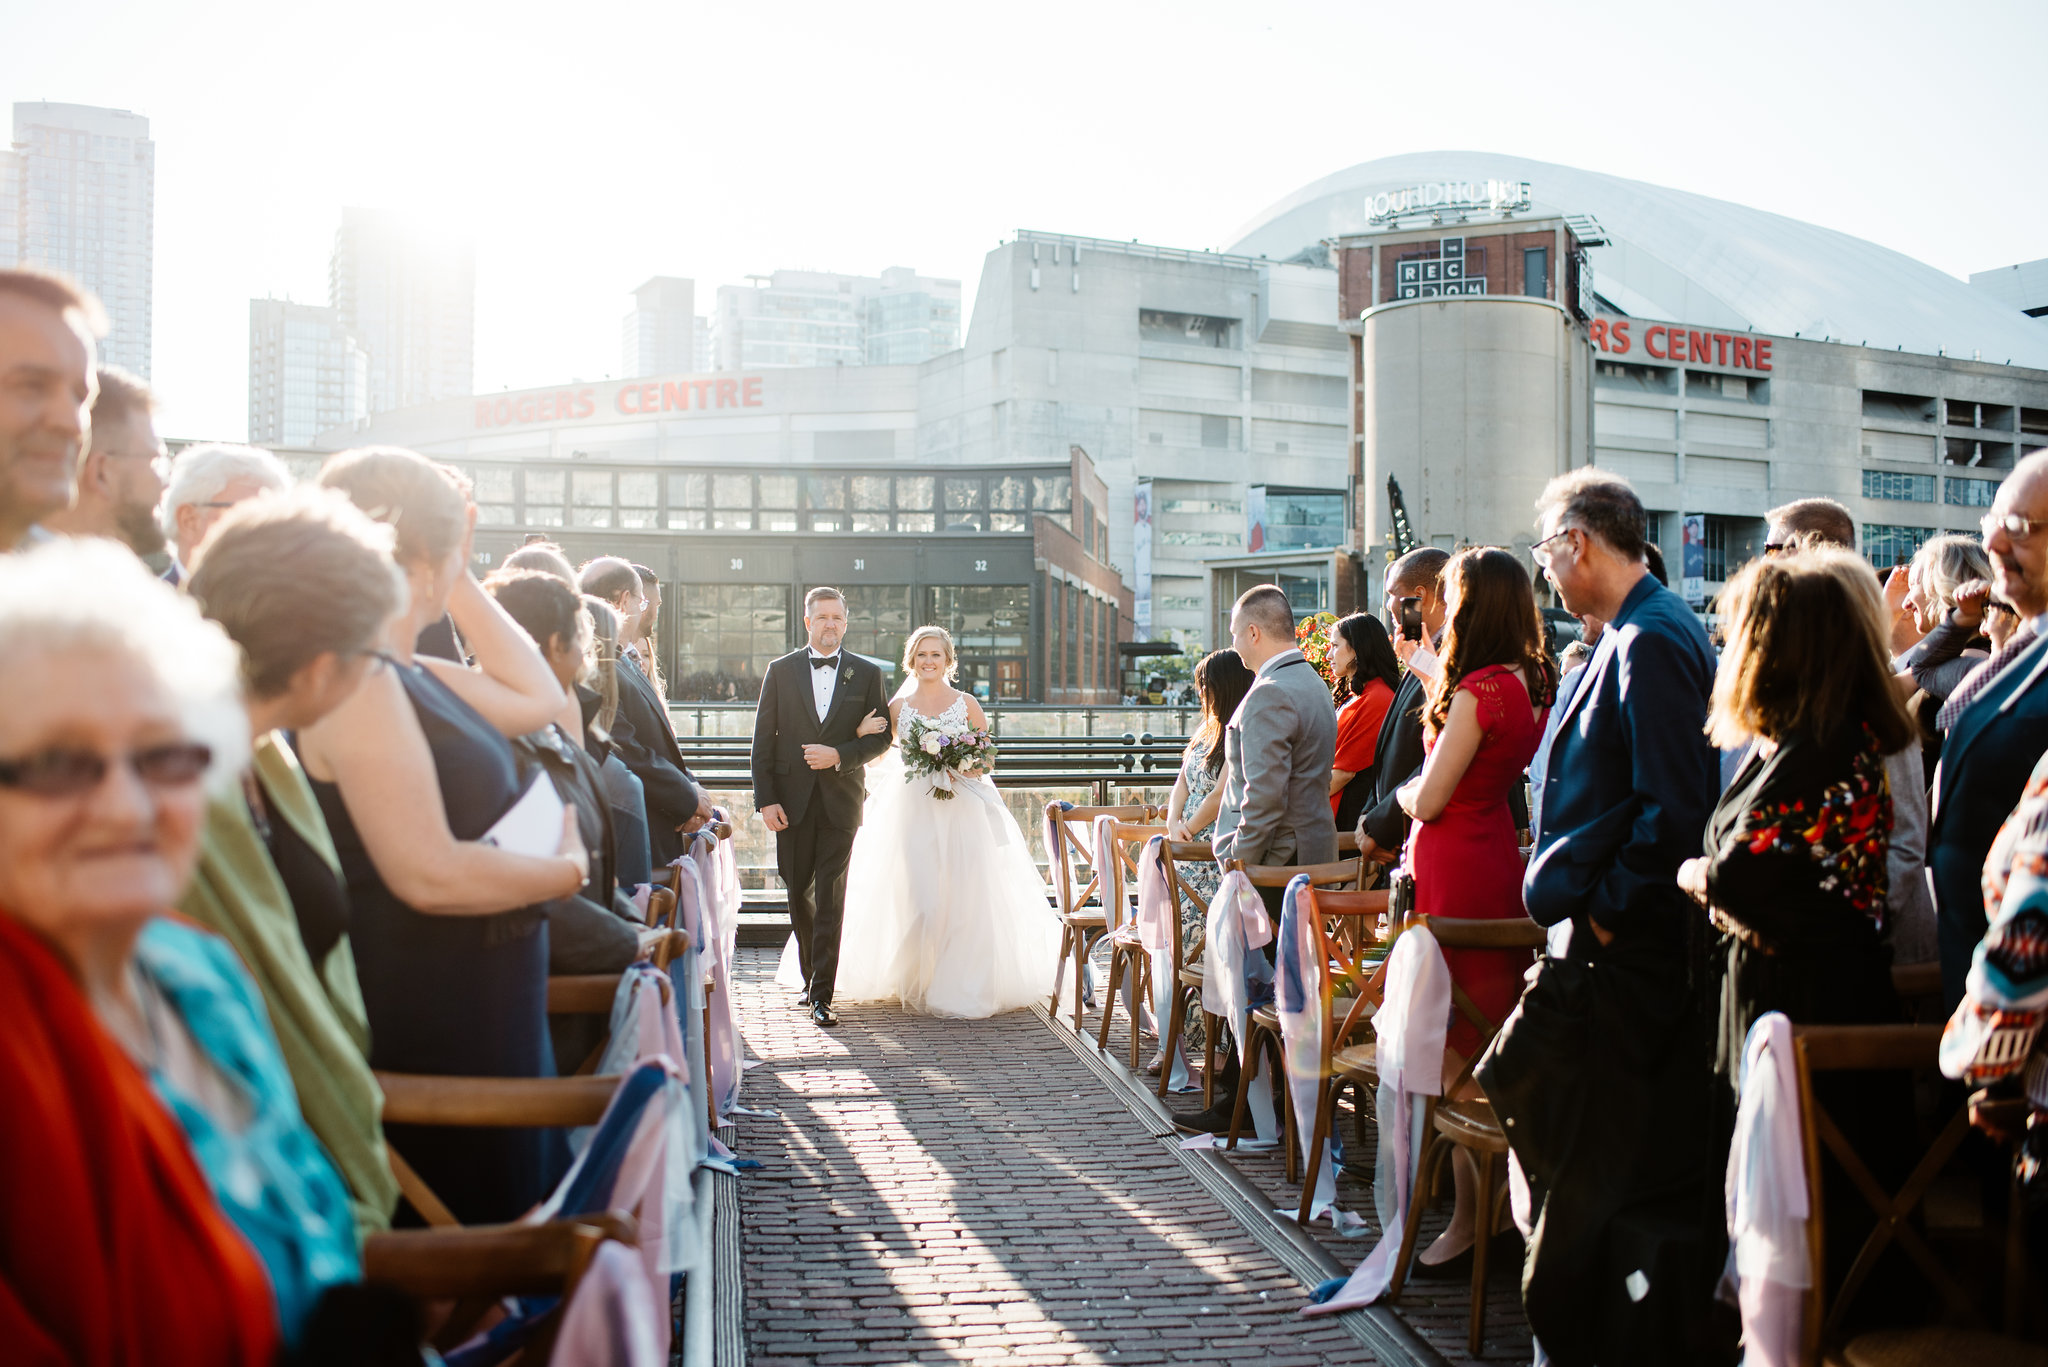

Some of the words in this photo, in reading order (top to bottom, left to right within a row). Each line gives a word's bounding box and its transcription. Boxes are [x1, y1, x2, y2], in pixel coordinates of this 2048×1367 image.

[1405, 263, 1459, 280] REC
[1645, 326, 1772, 371] CENTRE
[475, 388, 596, 429] ROGERS
[617, 377, 763, 415] CENTRE
[730, 558, 743, 570] 30
[854, 559, 864, 570] 31
[975, 559, 987, 571] 32
